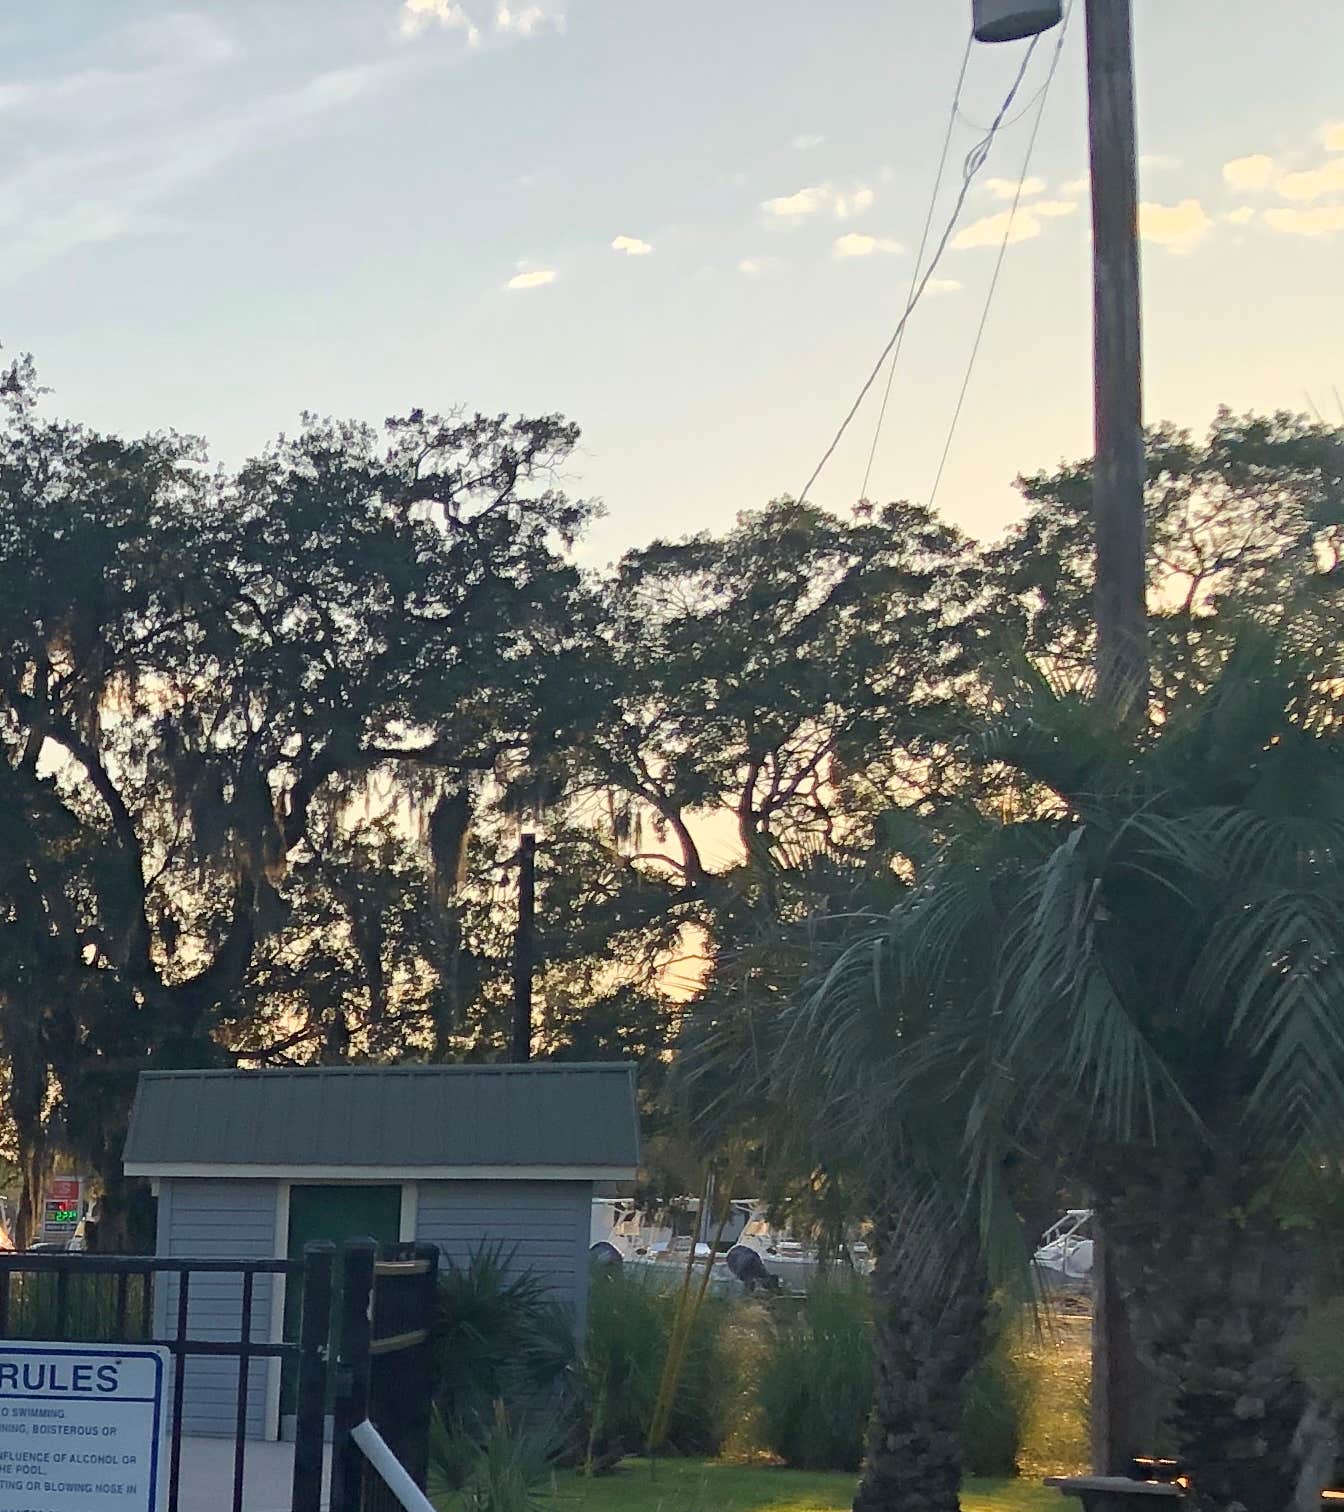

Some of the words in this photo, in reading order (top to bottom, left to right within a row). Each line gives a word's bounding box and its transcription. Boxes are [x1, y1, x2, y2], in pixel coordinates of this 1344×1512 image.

[32, 1423, 98, 1436] BOISTEROUS
[101, 1426, 117, 1437] OR
[52, 1453, 67, 1463] OF
[69, 1453, 119, 1465] ALCOHOL
[121, 1455, 137, 1466] OR
[26, 1481, 41, 1491] OR
[43, 1481, 92, 1493] BLOWING
[95, 1483, 123, 1494] NOSE
